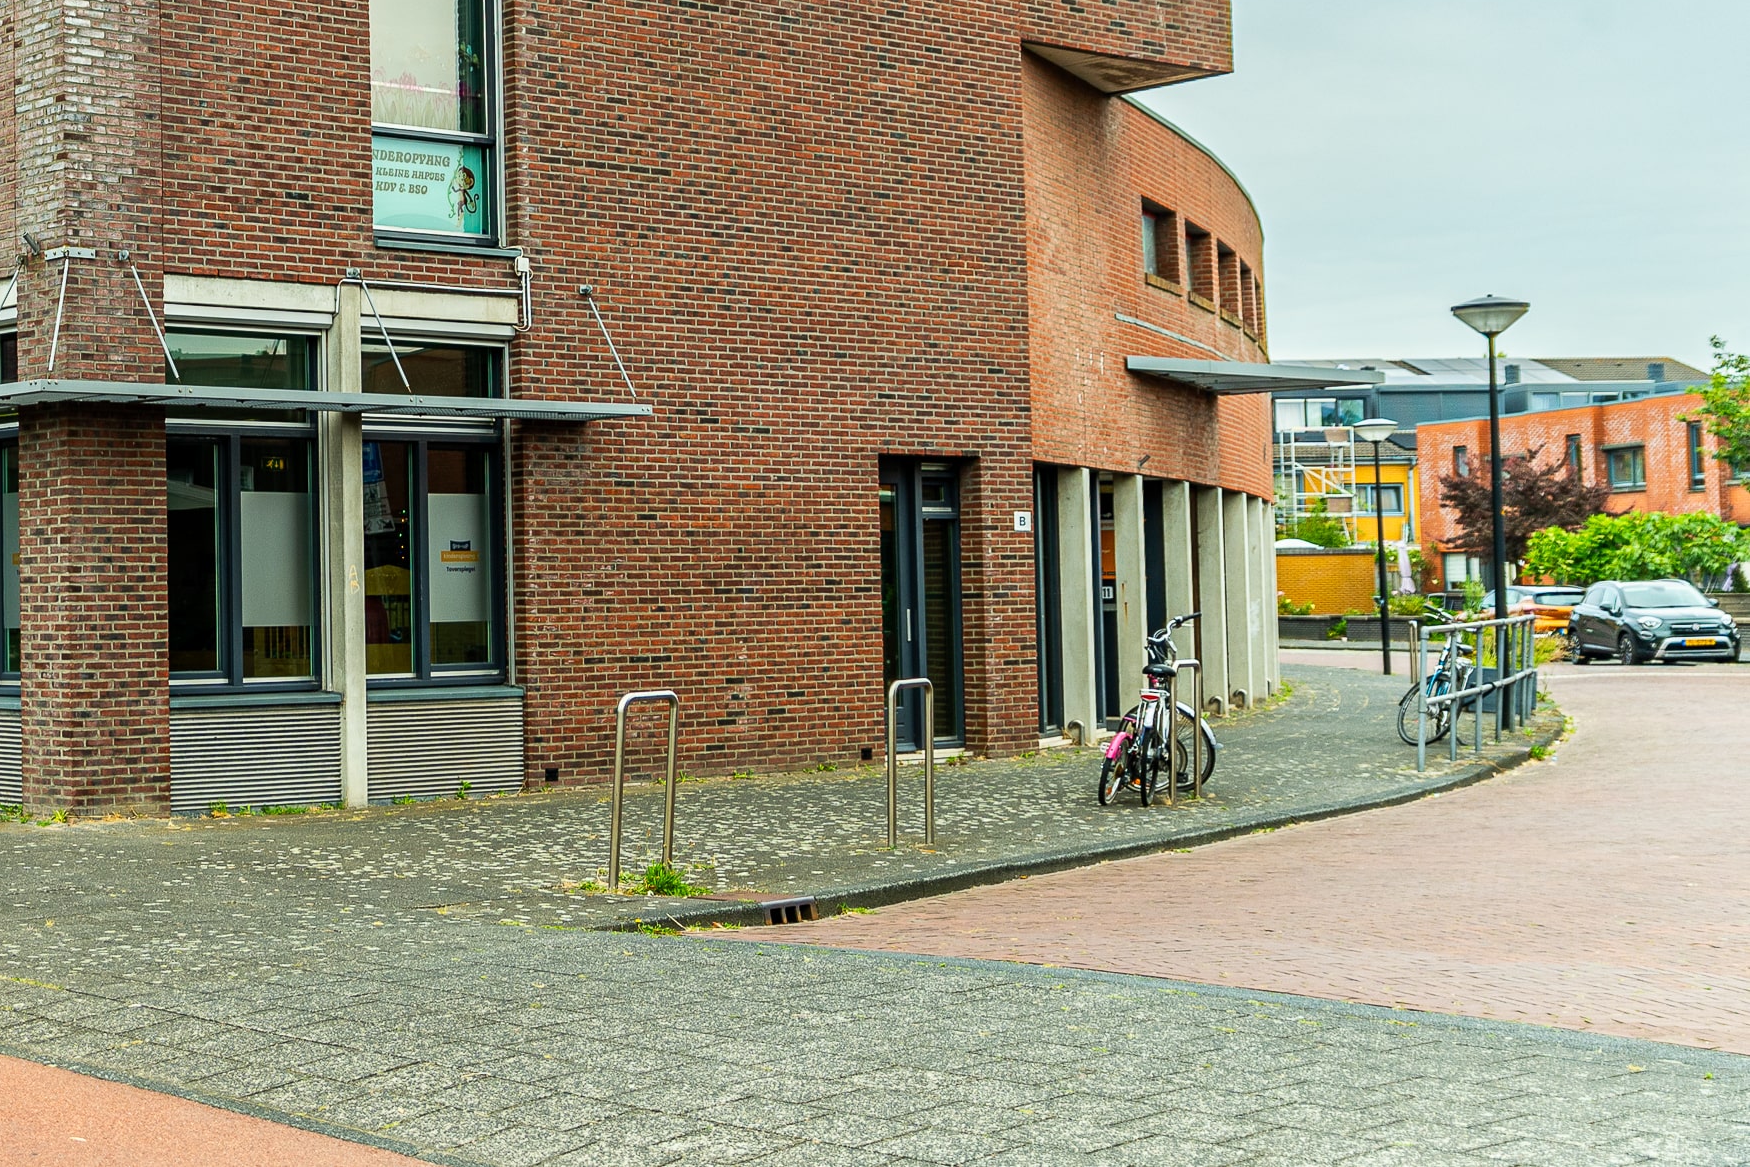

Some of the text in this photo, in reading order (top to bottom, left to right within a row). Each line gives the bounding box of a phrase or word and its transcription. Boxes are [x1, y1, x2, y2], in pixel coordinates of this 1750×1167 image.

[376, 167, 410, 178] KLEINE
[375, 181, 428, 195] KDV & BSO
[1019, 516, 1026, 526] B
[1102, 587, 1111, 598] 11
